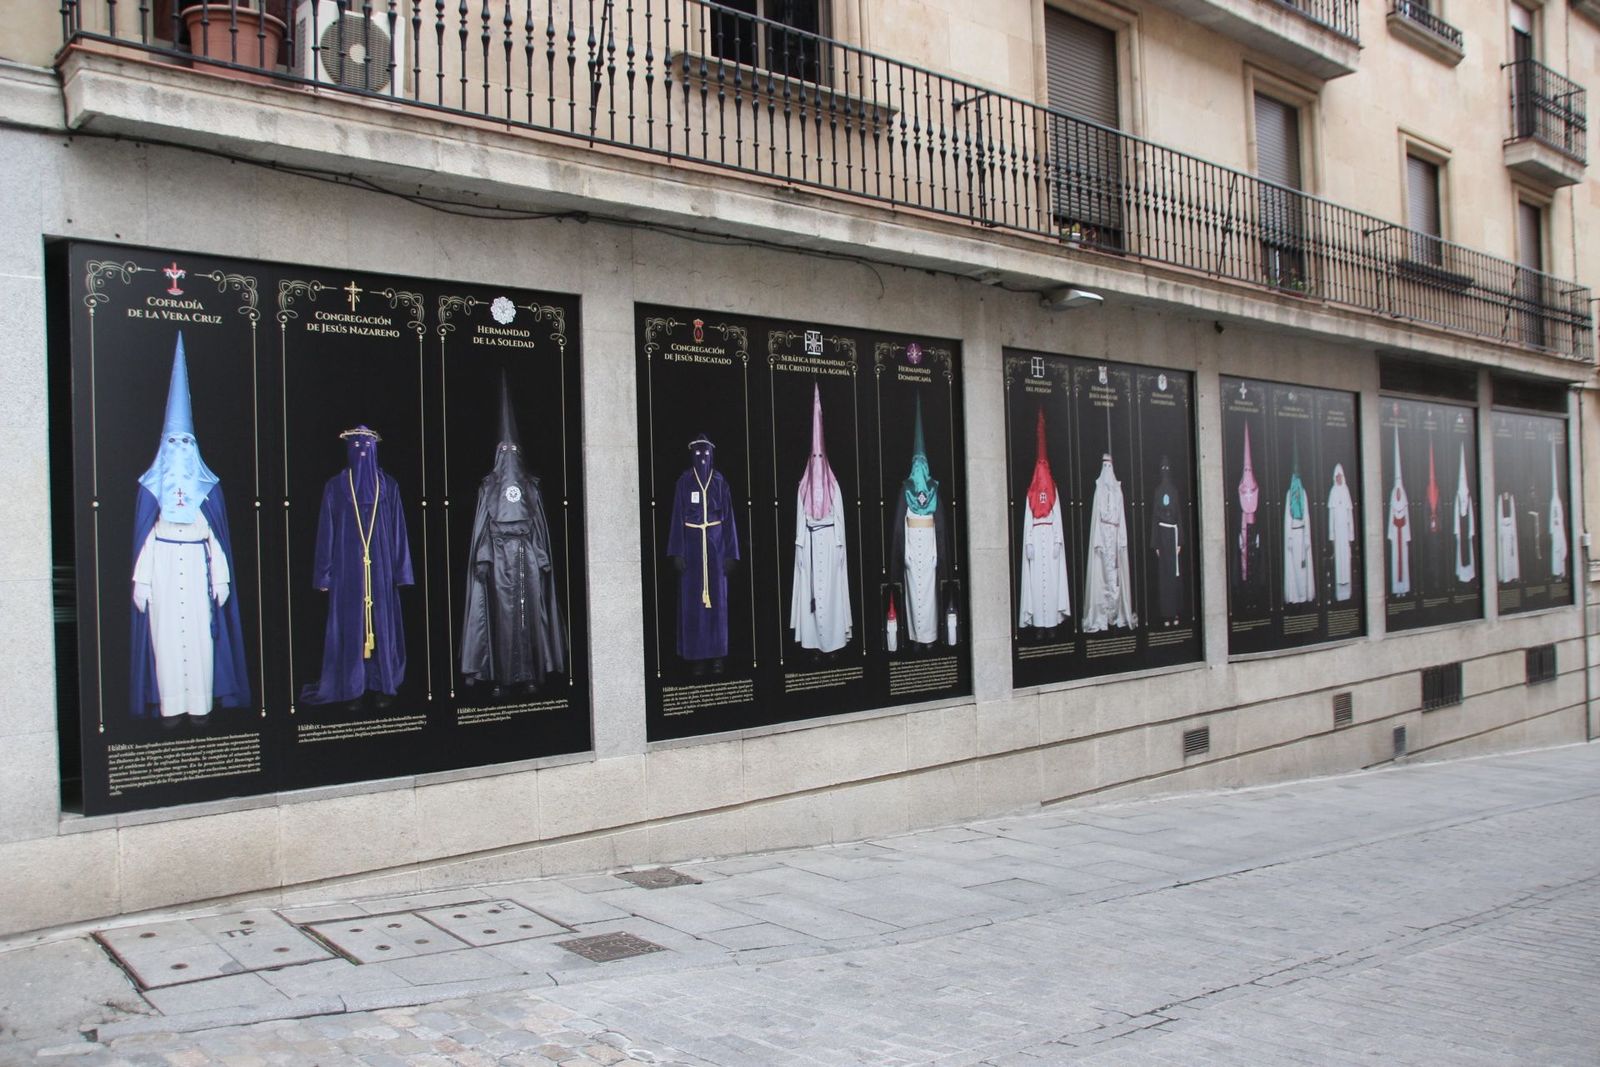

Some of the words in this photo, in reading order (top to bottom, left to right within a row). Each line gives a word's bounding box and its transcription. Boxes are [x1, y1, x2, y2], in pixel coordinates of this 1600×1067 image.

[147, 296, 204, 310] COFRADÍA
[128, 308, 143, 318] DE
[145, 310, 160, 320] LA
[162, 310, 191, 322] VERA
[193, 313, 223, 324] CRUZ
[315, 310, 392, 326] CONGREGACIÓN
[307, 322, 320, 332] DE
[322, 323, 348, 334] JESÚS
[350, 325, 400, 338] NAZARENO
[477, 325, 530, 338] HERMANDAD
[473, 336, 485, 345] DE
[486, 338, 496, 346] LA
[497, 338, 535, 349] SOLEDAD
[670, 343, 725, 355] CONGREGACIÓN
[664, 353, 674, 361] DE
[675, 353, 693, 362] JESÚS
[694, 355, 732, 365] RESCATADO
[776, 363, 788, 371] DEL
[789, 364, 811, 373] CRISTO
